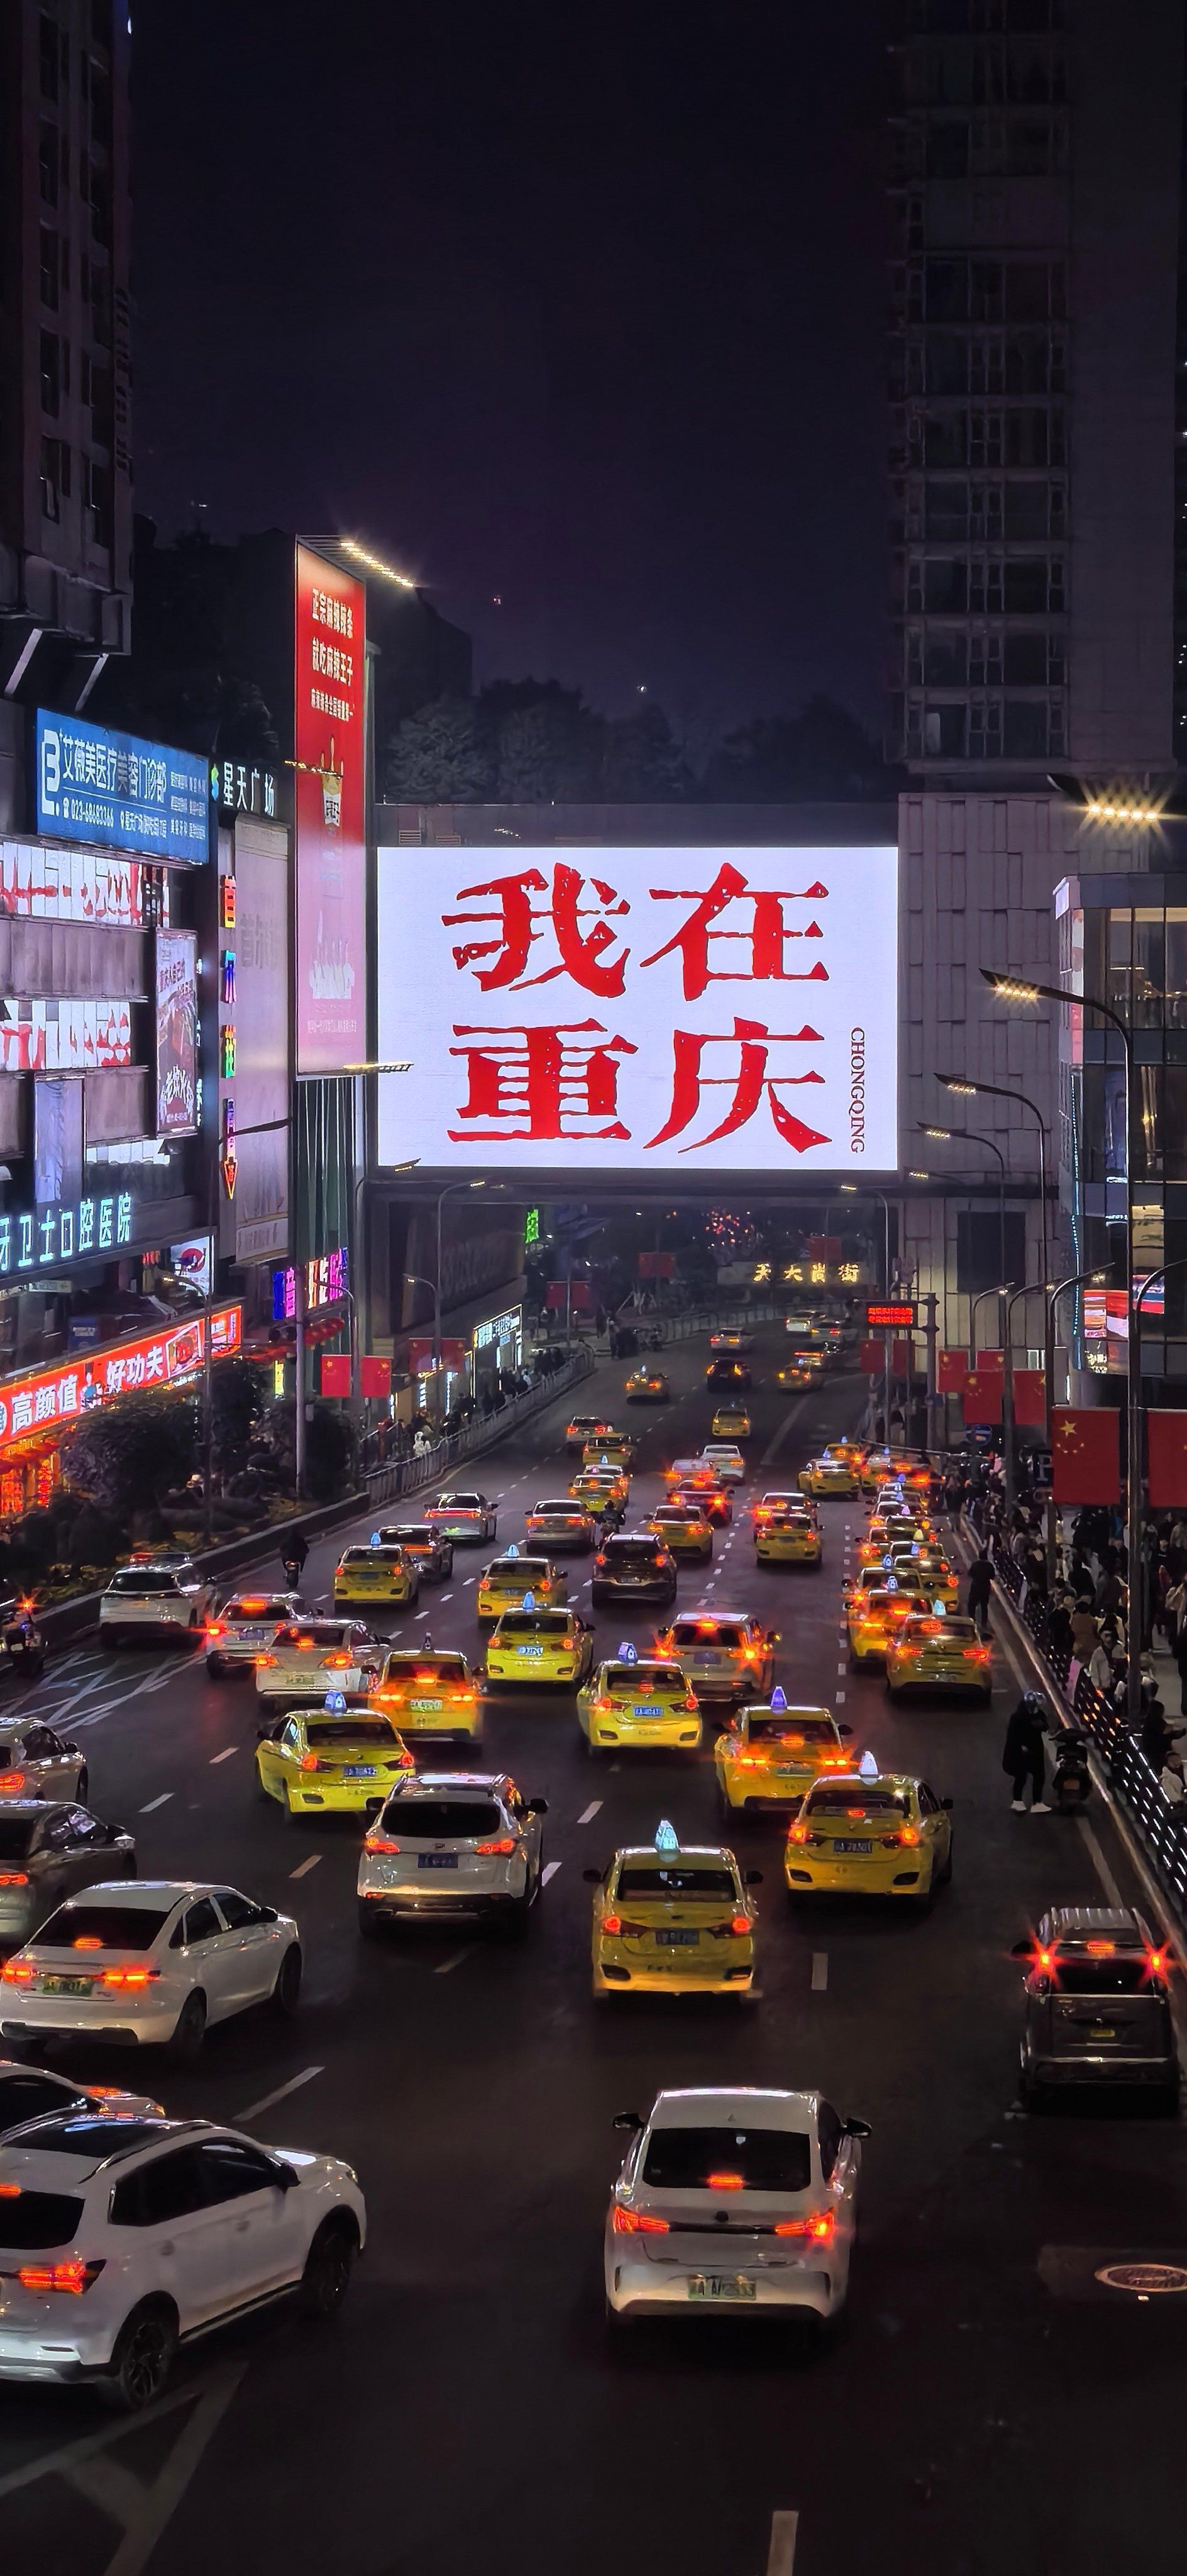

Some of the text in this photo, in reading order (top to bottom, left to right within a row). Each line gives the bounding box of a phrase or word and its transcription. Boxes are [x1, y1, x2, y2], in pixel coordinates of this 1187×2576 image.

[312, 637, 353, 687] 就吃麻辣王子
[224, 761, 274, 816] 星天广场
[441, 862, 830, 1001] 我在
[447, 1016, 833, 1153] 重庆
[849, 1027, 865, 1153] CHONGQING
[0, 1191, 132, 1271] 牙卫士口腔医院
[11, 1345, 165, 1435] 高颜值 好功夫
